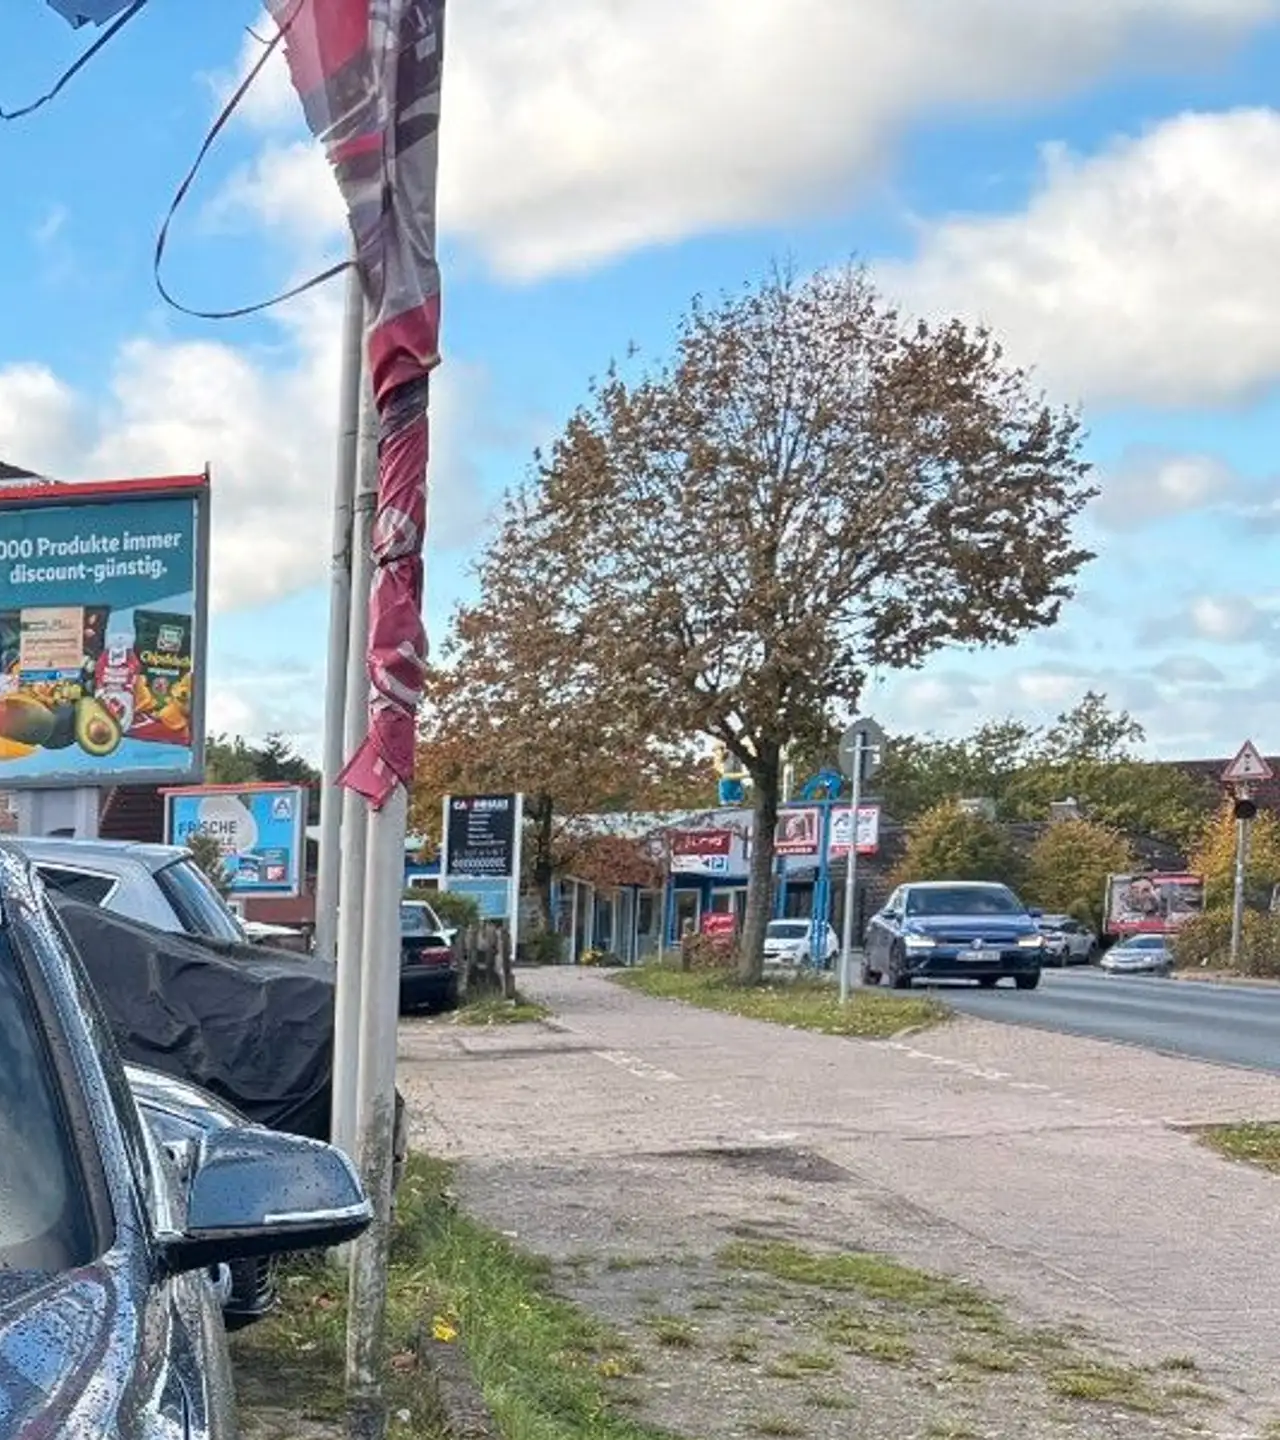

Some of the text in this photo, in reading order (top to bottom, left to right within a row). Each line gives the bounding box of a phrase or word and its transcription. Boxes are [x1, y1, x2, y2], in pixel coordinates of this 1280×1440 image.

[37, 534, 120, 556] Produkte
[123, 531, 183, 551] immer
[9, 555, 168, 584] discount-günstig.
